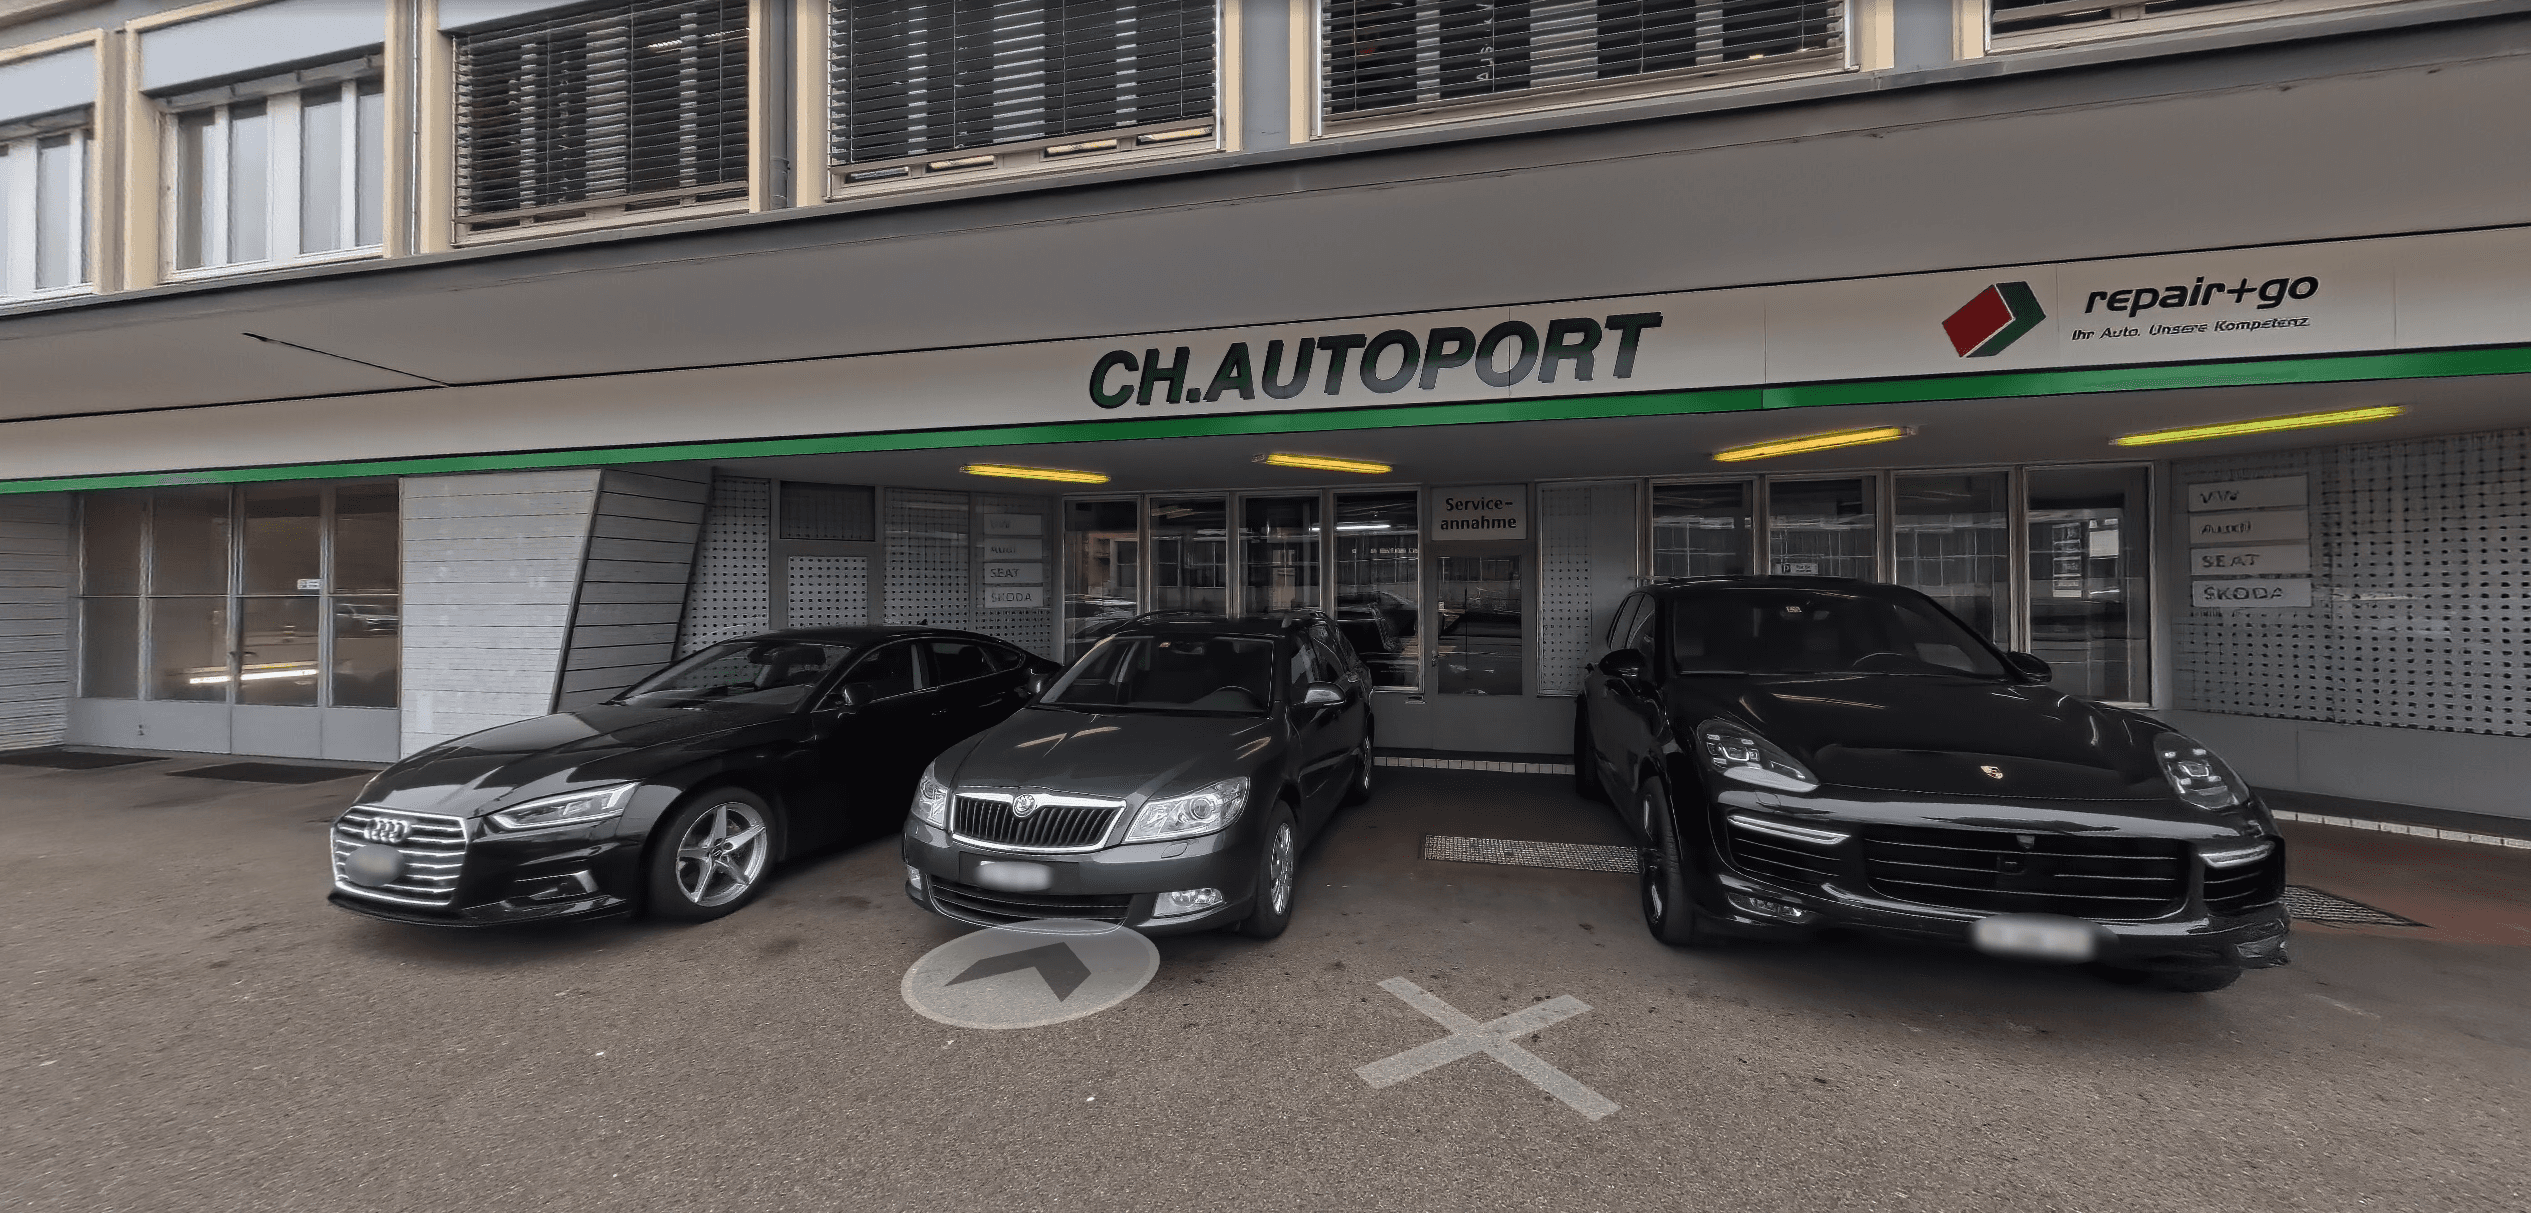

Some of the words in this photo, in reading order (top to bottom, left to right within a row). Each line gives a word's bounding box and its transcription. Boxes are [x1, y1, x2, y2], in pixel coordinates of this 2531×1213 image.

[2085, 276, 2319, 318] repair+go
[2072, 329, 2095, 341] Ihr
[2099, 326, 2141, 339] Auto.
[2149, 323, 2208, 336] Unsere
[1089, 312, 1664, 409] CH.AUTOPORT
[1446, 497, 1514, 512] Service-
[1440, 516, 1517, 531] annahme
[2202, 553, 2260, 568] SEAT
[990, 568, 1020, 578] SEAT
